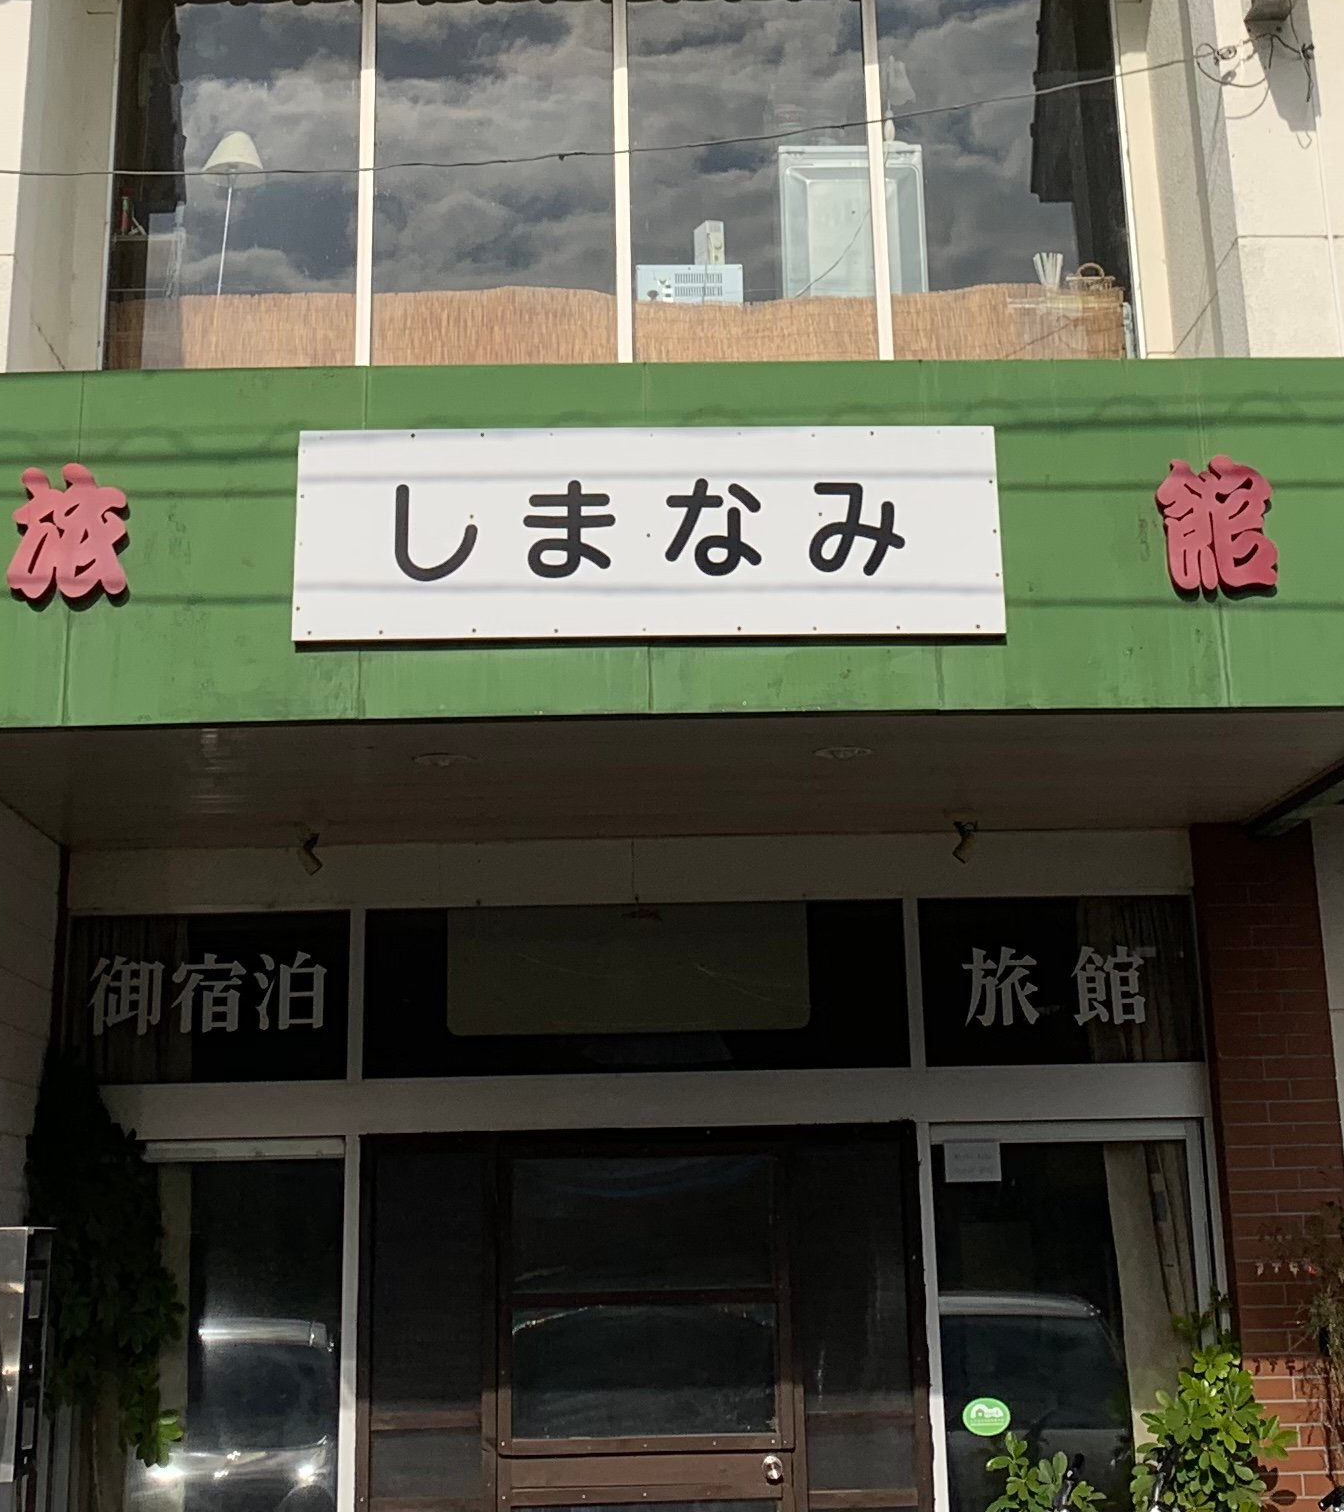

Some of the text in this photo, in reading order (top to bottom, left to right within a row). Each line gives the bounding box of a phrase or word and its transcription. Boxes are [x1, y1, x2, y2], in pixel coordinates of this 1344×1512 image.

[7, 454, 1278, 601] 旅 しまなみ 館
[88, 951, 328, 1036] 御宿泊
[961, 944, 1147, 1027] 旅館
